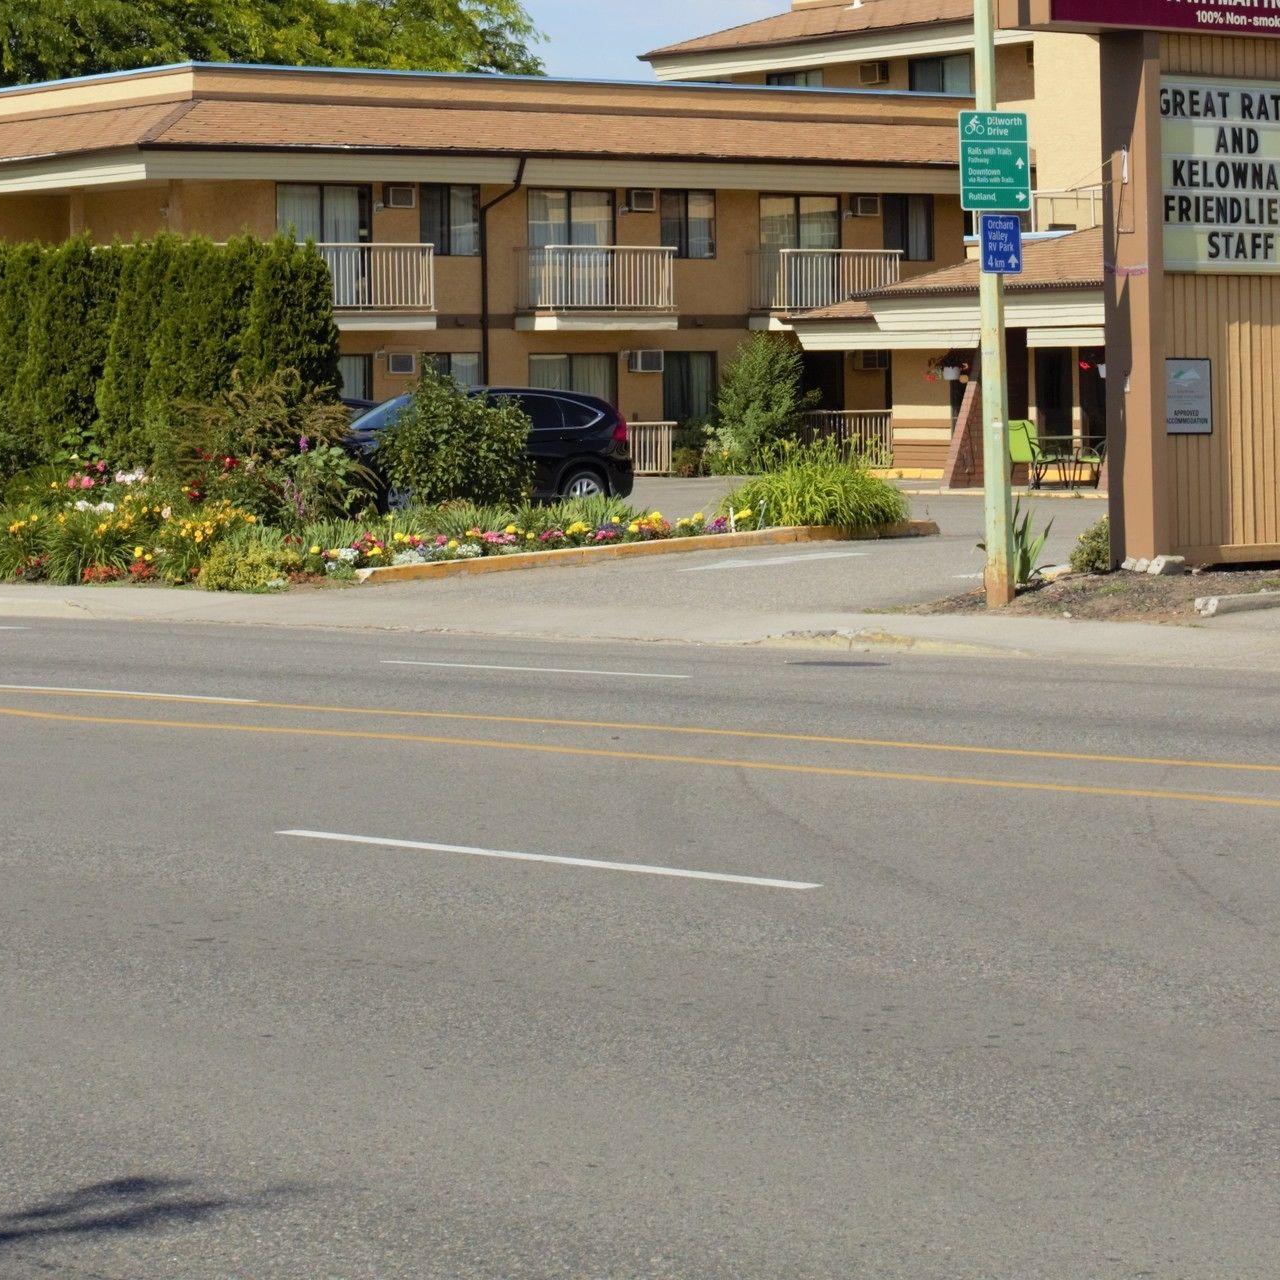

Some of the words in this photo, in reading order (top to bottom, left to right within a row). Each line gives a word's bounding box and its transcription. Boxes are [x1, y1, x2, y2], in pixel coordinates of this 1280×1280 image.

[1196, 10, 1224, 25] 100%
[1160, 88, 1229, 118] GREAT
[987, 117, 1022, 126] Dilworth
[987, 126, 1009, 136] Drive
[1215, 126, 1259, 154] AND
[967, 147, 982, 156] Rails
[968, 167, 1001, 176] Downtown
[987, 220, 1014, 230] Orchard
[988, 230, 1009, 242] Valley
[988, 241, 997, 251] RV
[999, 241, 1014, 252] Park
[1207, 231, 1274, 260] STAFF
[987, 254, 994, 268] 4
[994, 257, 1005, 268] km
